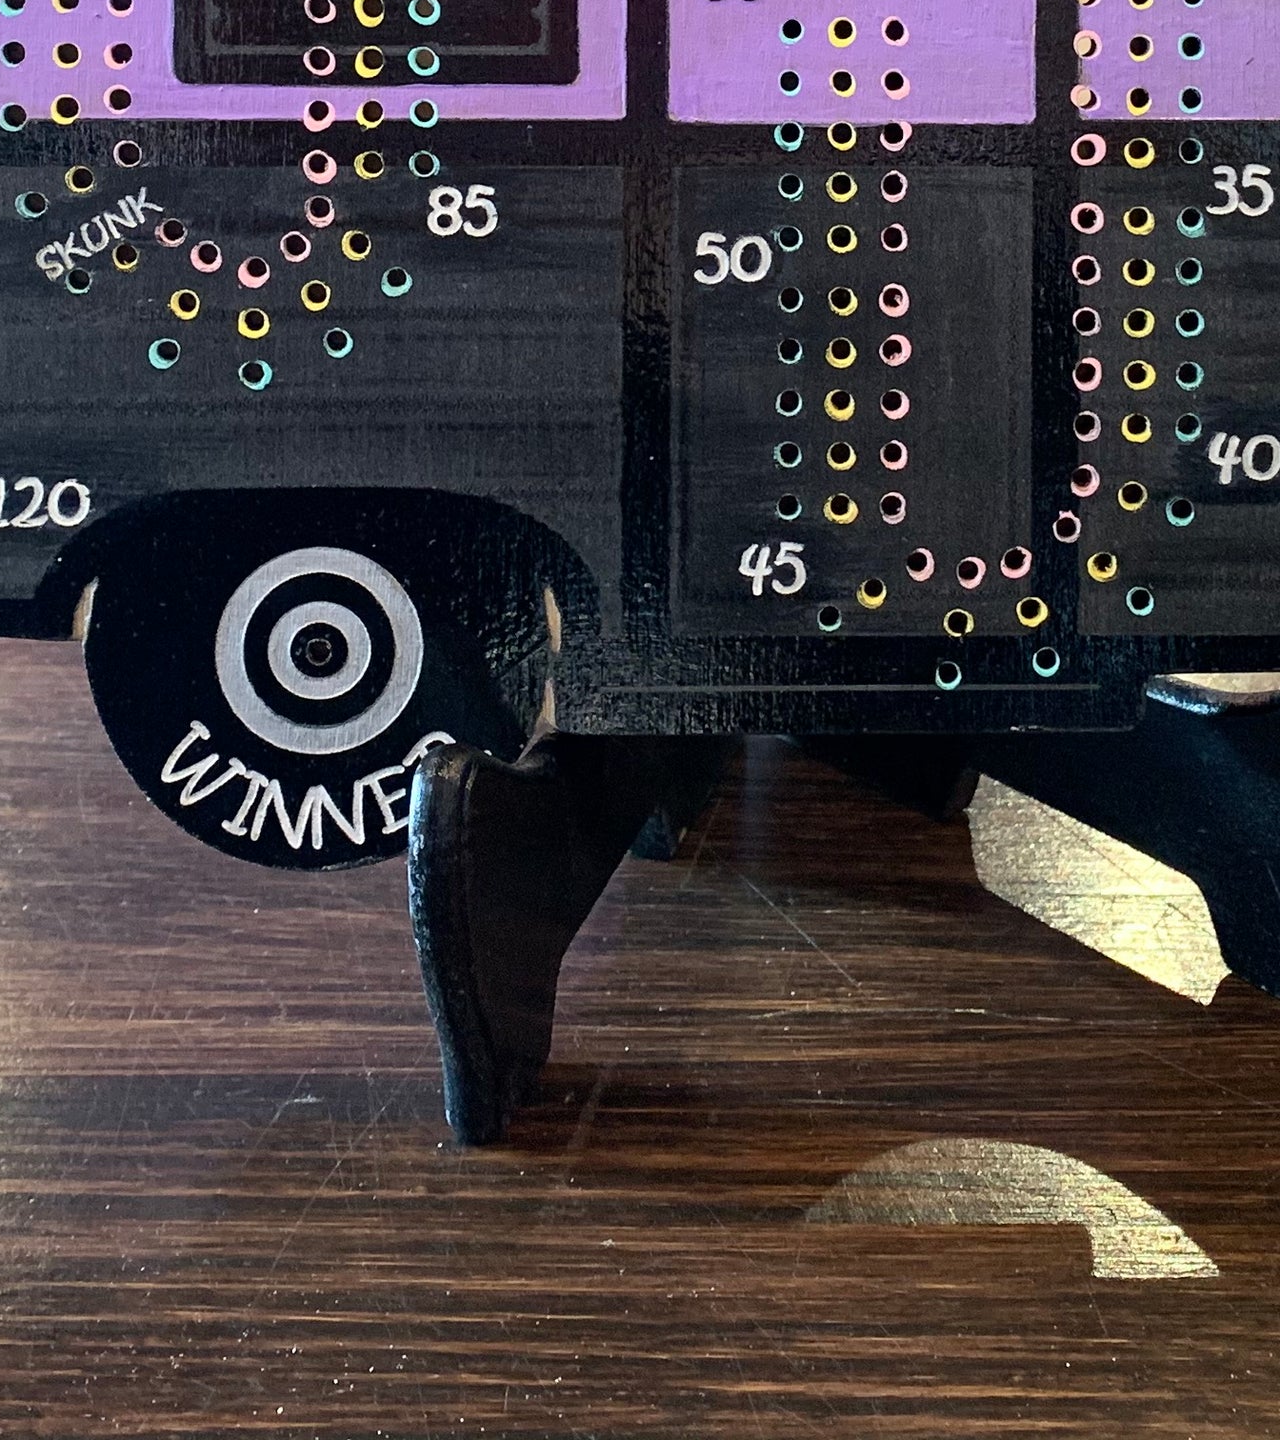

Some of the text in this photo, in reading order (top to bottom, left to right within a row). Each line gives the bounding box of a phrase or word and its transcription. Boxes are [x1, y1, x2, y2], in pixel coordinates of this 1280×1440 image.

[426, 183, 499, 238] 85
[1206, 164, 1274, 217] 35
[35, 186, 164, 282] SKUNK
[693, 231, 773, 284] 50
[738, 540, 807, 595] 45
